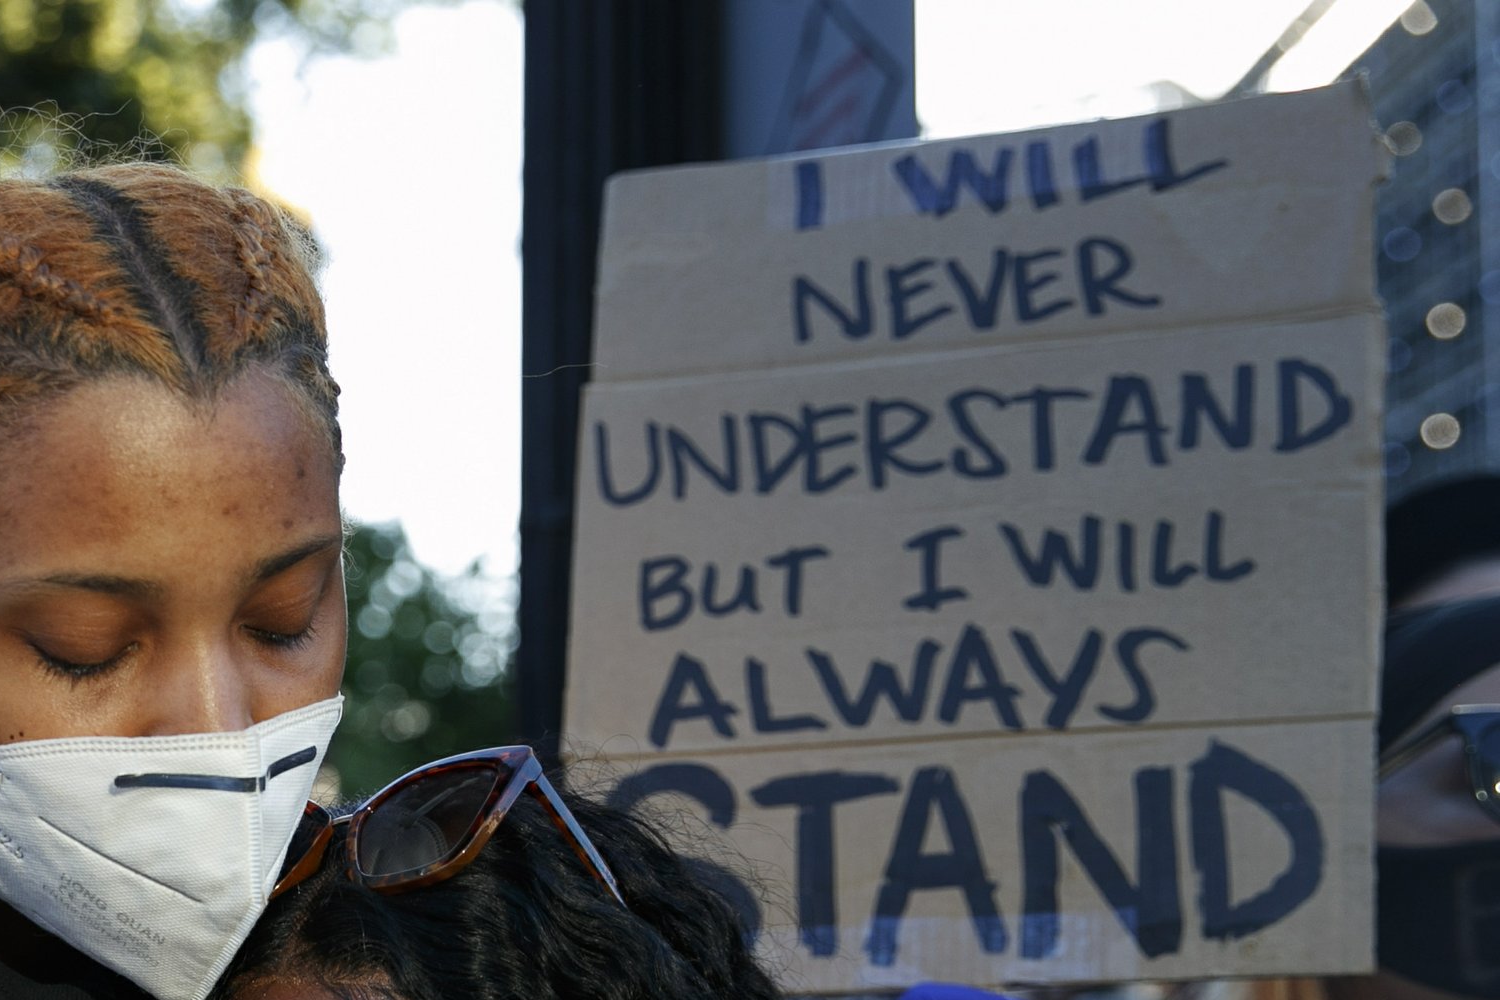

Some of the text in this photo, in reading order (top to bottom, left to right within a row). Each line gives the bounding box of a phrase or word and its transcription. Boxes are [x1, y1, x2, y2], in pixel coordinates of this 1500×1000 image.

[794, 117, 1228, 231] I WILL
[792, 236, 1162, 343] NEVER
[593, 357, 1354, 506] UNDERSTAND
[639, 509, 1257, 632] BUT I WILL
[649, 623, 1190, 749] ALWAYS
[117, 912, 165, 945] QUAN
